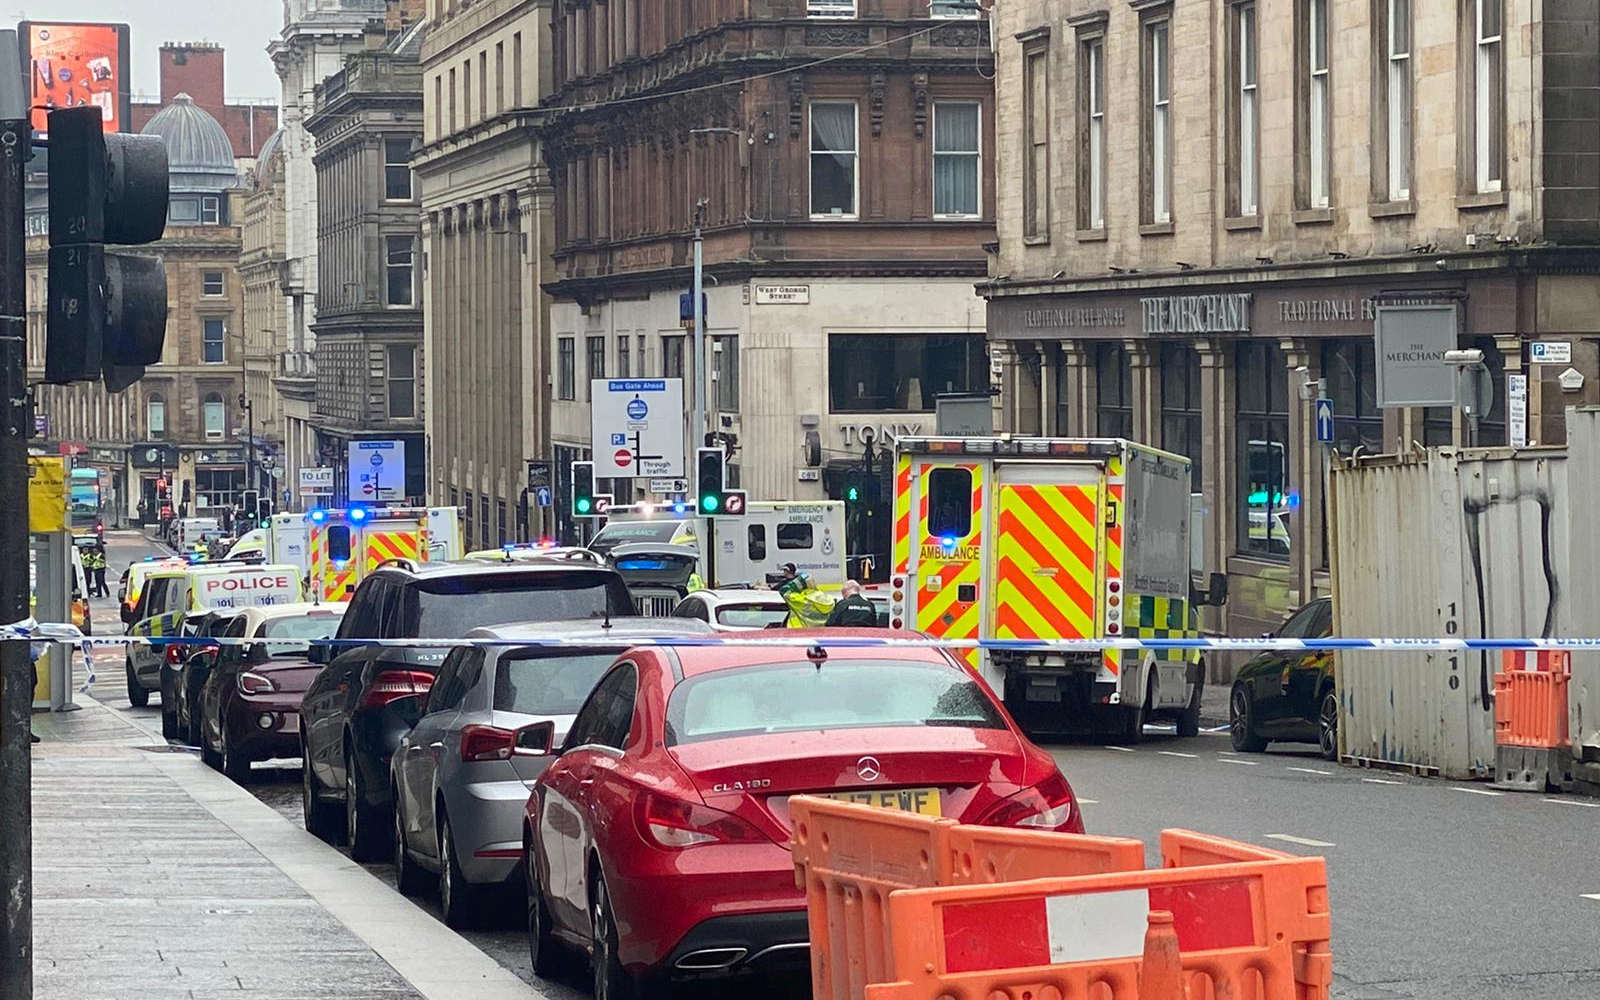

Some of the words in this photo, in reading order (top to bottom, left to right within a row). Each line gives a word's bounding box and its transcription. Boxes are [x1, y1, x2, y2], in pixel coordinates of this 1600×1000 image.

[1140, 297, 1167, 334] THE
[1168, 292, 1251, 334] MERCHANT
[1279, 299, 1356, 322] TRADITIONAL
[1410, 343, 1424, 351] THE
[1535, 345, 1544, 356] P
[643, 382, 664, 390] Ahead
[643, 461, 671, 469] Through
[646, 467, 668, 475] traffic
[302, 472, 313, 481] TO
[316, 472, 331, 480] LET
[788, 505, 824, 514] EMERGENCY
[789, 514, 824, 523] AMBULANCE
[920, 546, 980, 560] AMBULANCE
[206, 576, 289, 593] POLICE
[217, 599, 232, 608] 101
[261, 596, 275, 606] 101
[713, 783, 744, 792] CLA
